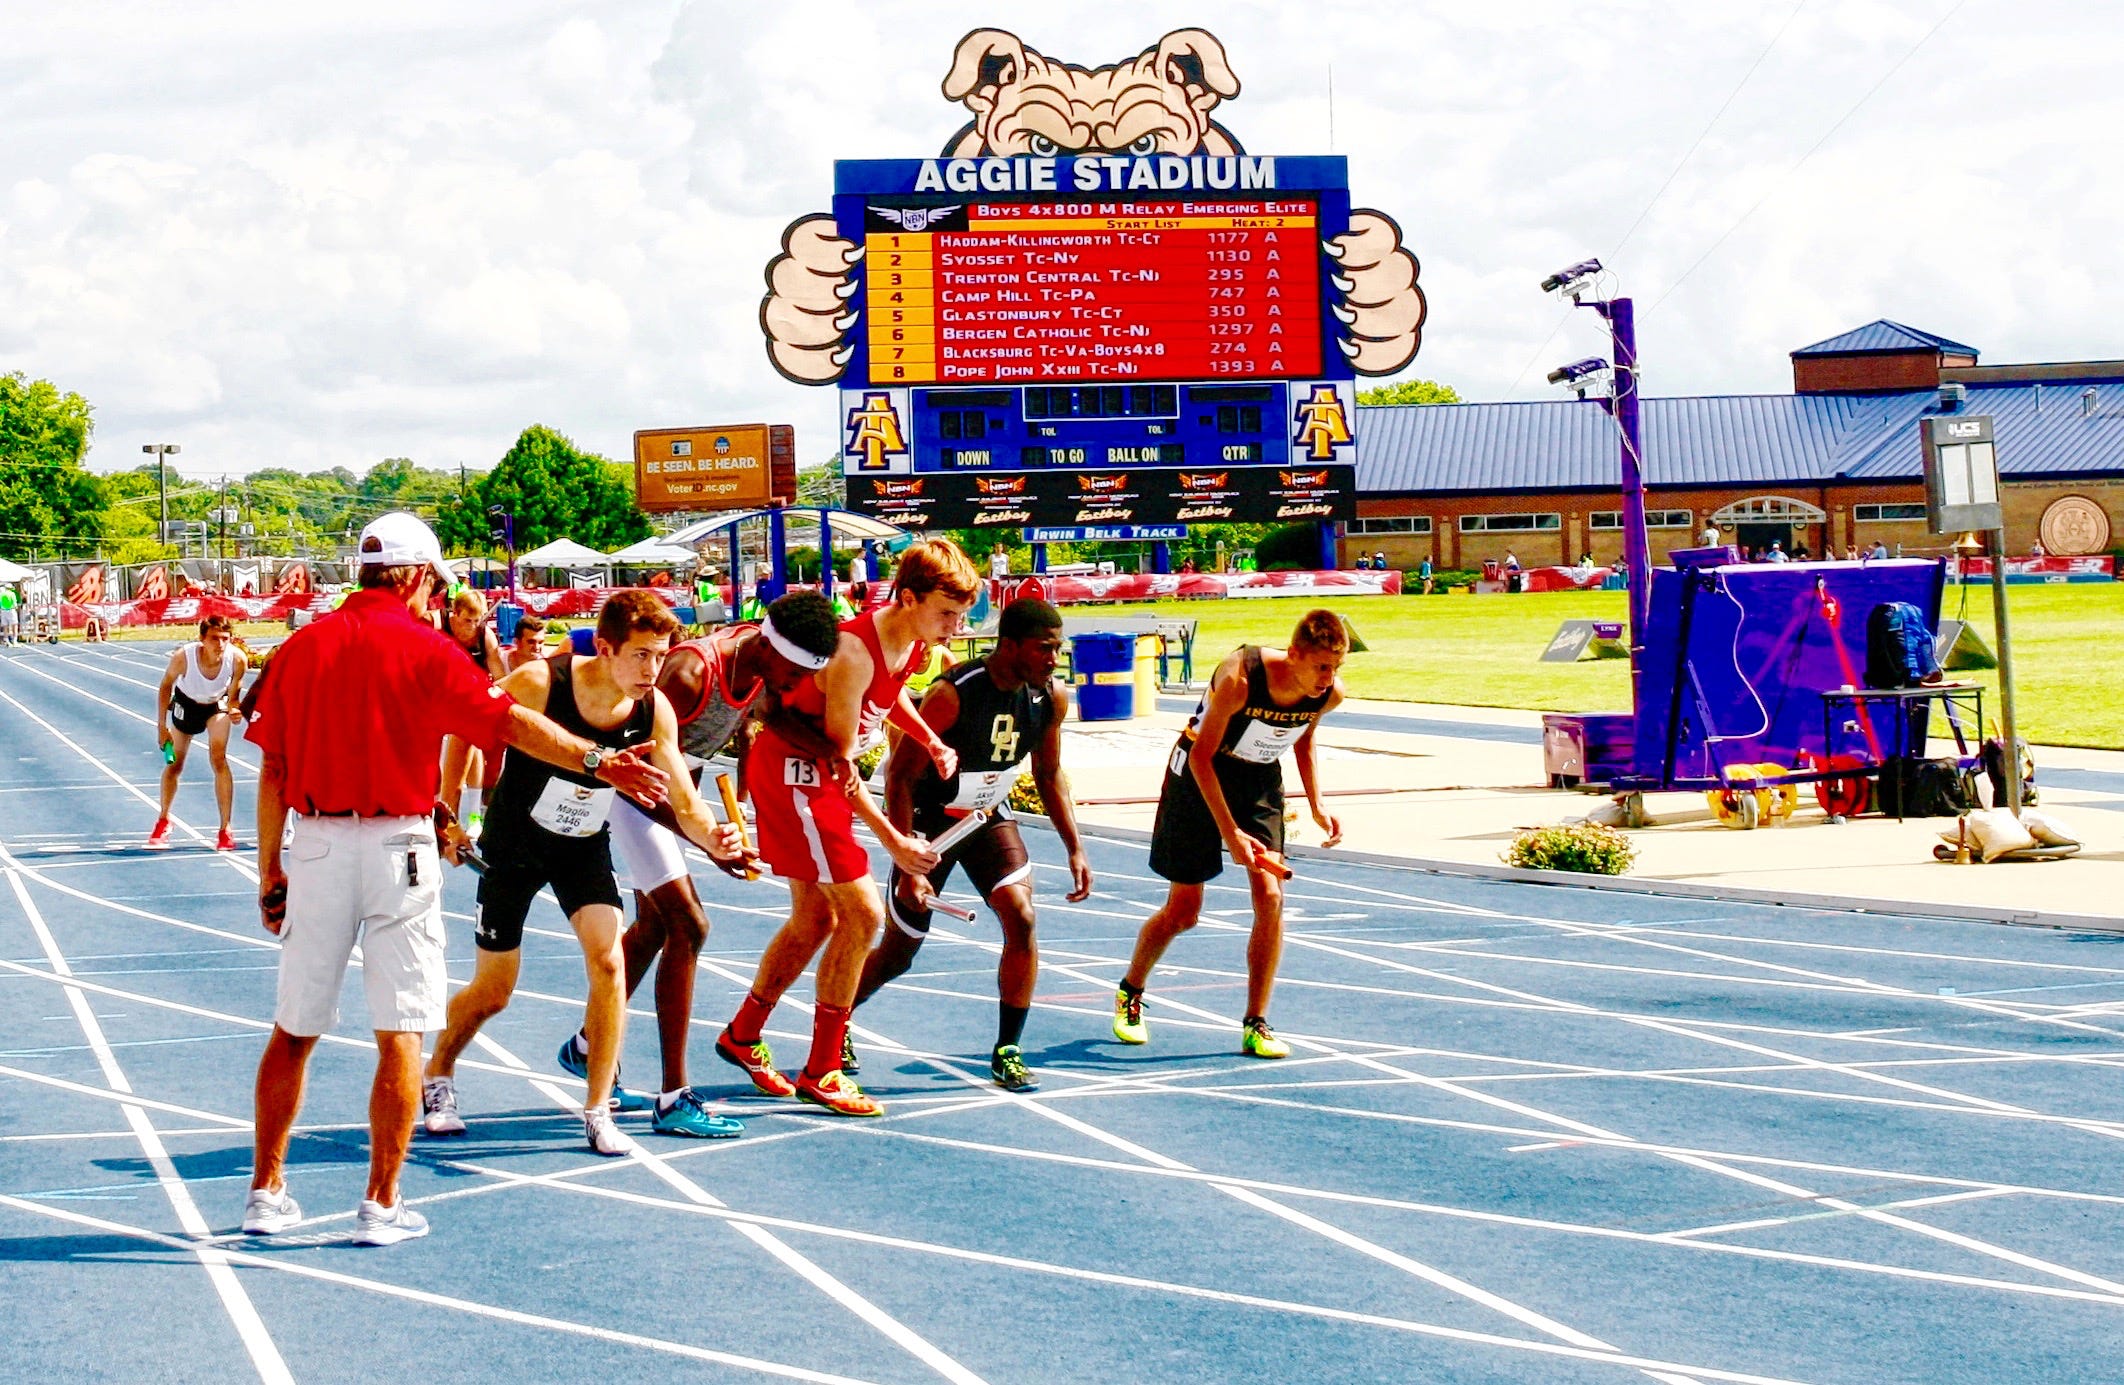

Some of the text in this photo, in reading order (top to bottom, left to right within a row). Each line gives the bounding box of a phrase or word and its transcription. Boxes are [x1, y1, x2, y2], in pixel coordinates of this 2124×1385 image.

[914, 156, 1275, 192] AGGIE STADIUM
[1099, 203, 1116, 215] M
[1122, 203, 1175, 215] RELAY
[1182, 202, 1259, 214] EMERGING
[1265, 202, 1307, 213] ELITE
[1107, 219, 1182, 229] START LIST
[1276, 218, 1285, 227] 2
[891, 236, 900, 247] 1
[1208, 232, 1249, 244] 1177
[1264, 232, 1278, 243] A
[891, 255, 901, 266] 2
[1207, 251, 1251, 262] 1130
[1266, 250, 1280, 261] A
[891, 273, 902, 285] 3
[942, 272, 1019, 284] TRENTON
[1026, 271, 1101, 283] CENTRAL
[1208, 270, 1244, 280] 295
[1266, 268, 1280, 280] A
[890, 292, 904, 303] 4
[942, 290, 990, 303] CAMP
[997, 289, 1032, 302] HILL
[1208, 287, 1245, 298] 747
[1266, 286, 1280, 298] A
[892, 310, 903, 322] 5
[942, 308, 1062, 321] GLASTONBURY
[1208, 306, 1246, 317] 350
[1268, 304, 1282, 316] A
[892, 329, 904, 341] 6
[943, 327, 1007, 340] BERGEN
[1013, 326, 1092, 339] CATHOLIC
[1208, 324, 1254, 335] 1297
[1269, 323, 1282, 334] A
[893, 348, 904, 360] 7
[943, 346, 1033, 359] BLACKSBURG
[1210, 342, 1247, 354] 274
[1268, 342, 1282, 353] A
[893, 366, 905, 378] 8
[944, 365, 986, 377] POPE
[995, 364, 1034, 379] JOHN
[1209, 360, 1255, 373] 1393
[1270, 360, 1284, 371] A
[956, 451, 990, 466] DOWN
[1050, 449, 1084, 463] TO GO
[1108, 447, 1158, 462] BALL ON
[1222, 446, 1248, 461] QTR
[646, 457, 759, 473] BE SEEN. BE HEARD.
[666, 482, 738, 494] VoterID.nc.gov
[1033, 526, 1178, 540] IRWIN BELK TRACK
[1245, 708, 1318, 722] INVICTUS
[791, 760, 814, 784] 13
[556, 815, 582, 827] 2446
